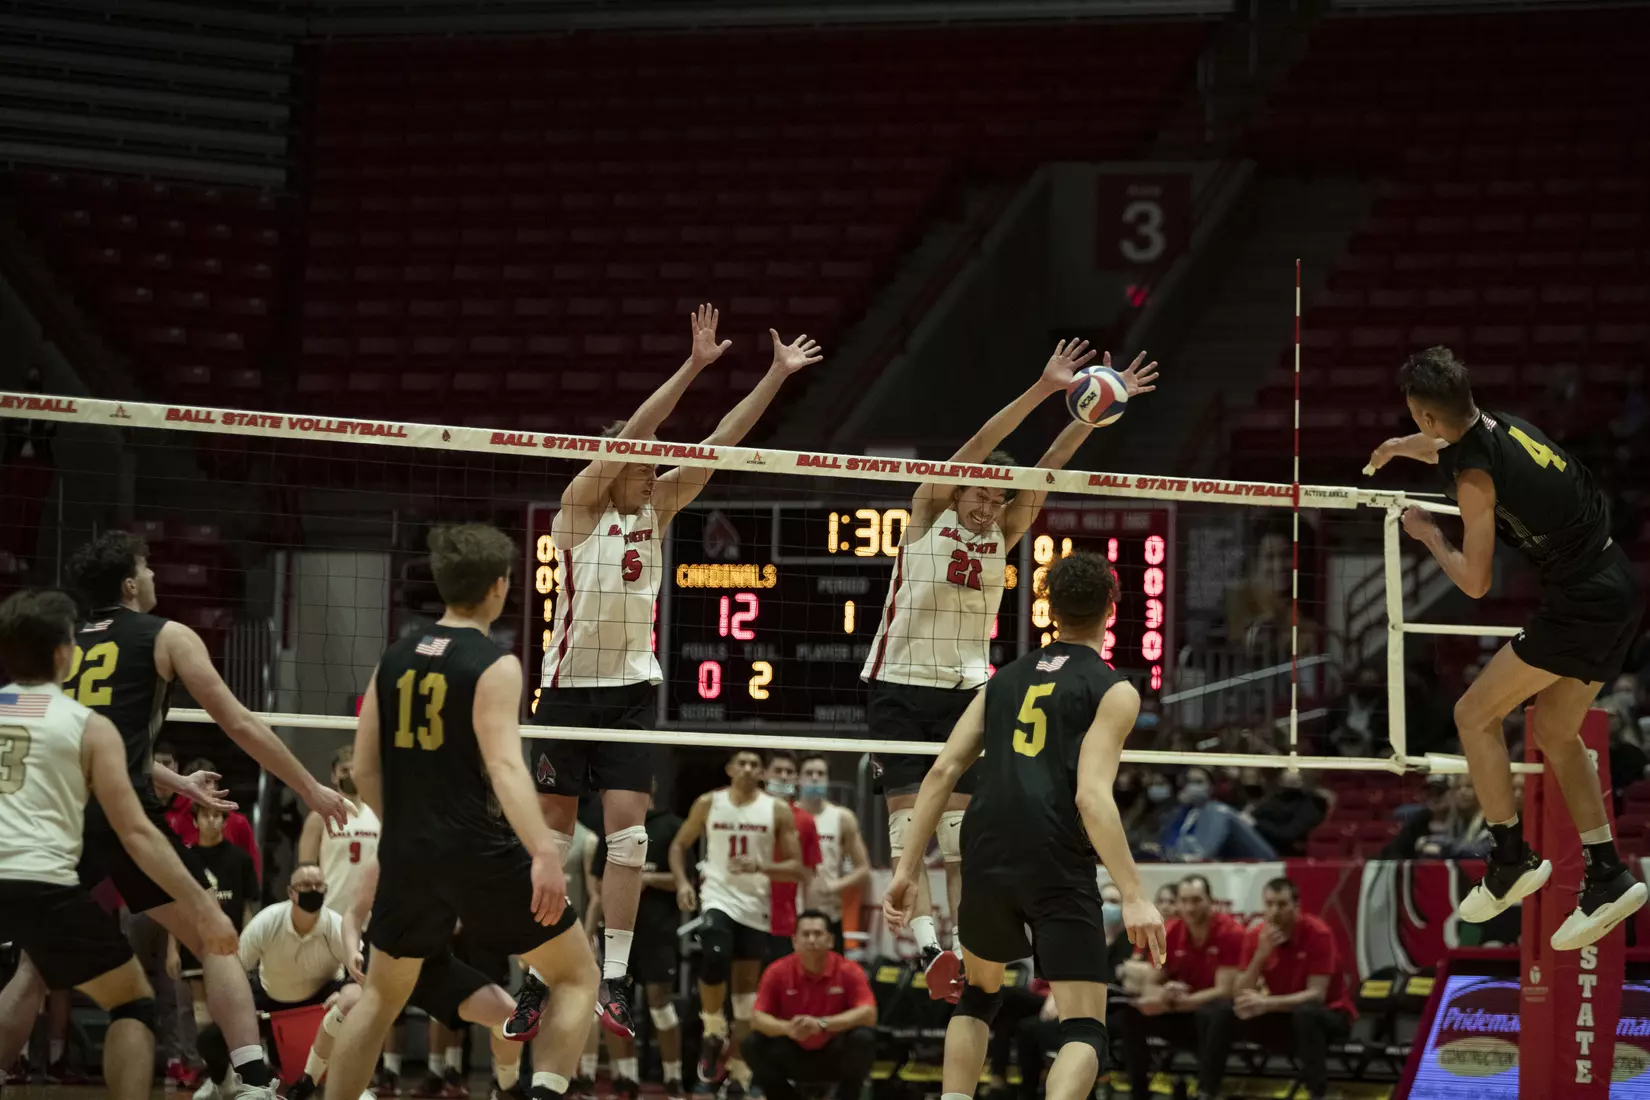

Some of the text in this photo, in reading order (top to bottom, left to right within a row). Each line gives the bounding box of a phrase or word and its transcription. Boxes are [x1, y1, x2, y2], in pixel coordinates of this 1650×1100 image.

[1118, 200, 1167, 263] 3
[165, 408, 408, 439] BALL STATE VOLLEYBALL
[489, 432, 719, 461] BALL STATE VOLLEYBALL
[1508, 425, 1567, 472] 4
[796, 454, 1014, 481] BALL STATE VOLLEYBALL
[1088, 474, 1294, 498] BALL STATE VOLLEYBALL
[1304, 489, 1327, 498] ACTIVE
[828, 508, 911, 557] 1:30
[622, 549, 643, 582] 5
[676, 564, 777, 588] CARDINALS
[946, 549, 982, 591] 22
[718, 592, 759, 641] 12
[844, 600, 855, 634] 1
[697, 660, 773, 699] 0 2
[394, 669, 448, 750] 13
[1012, 682, 1056, 757] 5
[349, 841, 361, 864] 9
[728, 835, 748, 858] 11
[1575, 945, 1599, 1084] STATE
